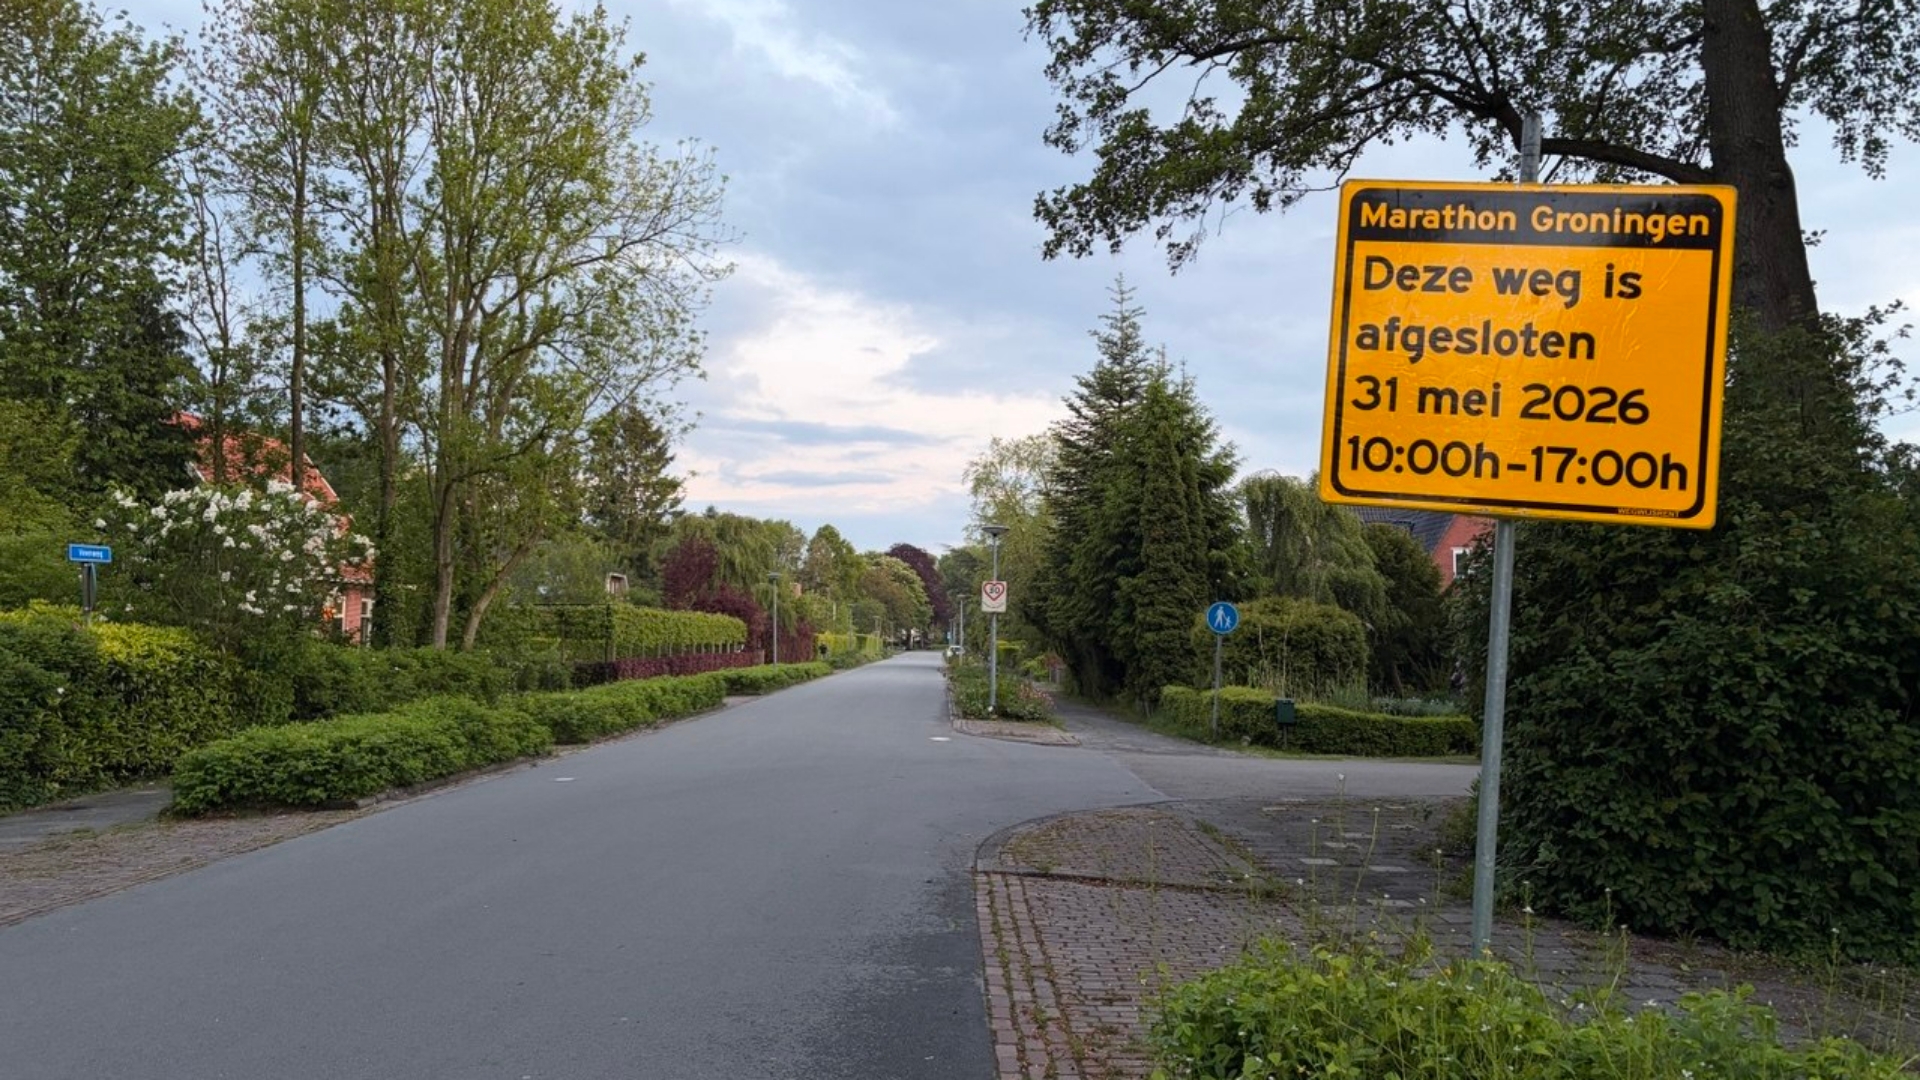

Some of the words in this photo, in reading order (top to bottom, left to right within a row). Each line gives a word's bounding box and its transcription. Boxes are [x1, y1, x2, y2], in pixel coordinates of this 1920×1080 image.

[1360, 202, 1518, 232] Marathon
[1530, 204, 1711, 243] Groningen
[1364, 256, 1473, 293] Deze
[1493, 269, 1582, 308] weg
[1604, 264, 1643, 299] is
[1356, 317, 1595, 363] afgesloten
[1352, 375, 1398, 412] 31
[1417, 382, 1500, 417] mei
[1520, 383, 1649, 425] 2026
[1347, 435, 1688, 491] 10:00h-17:00h
